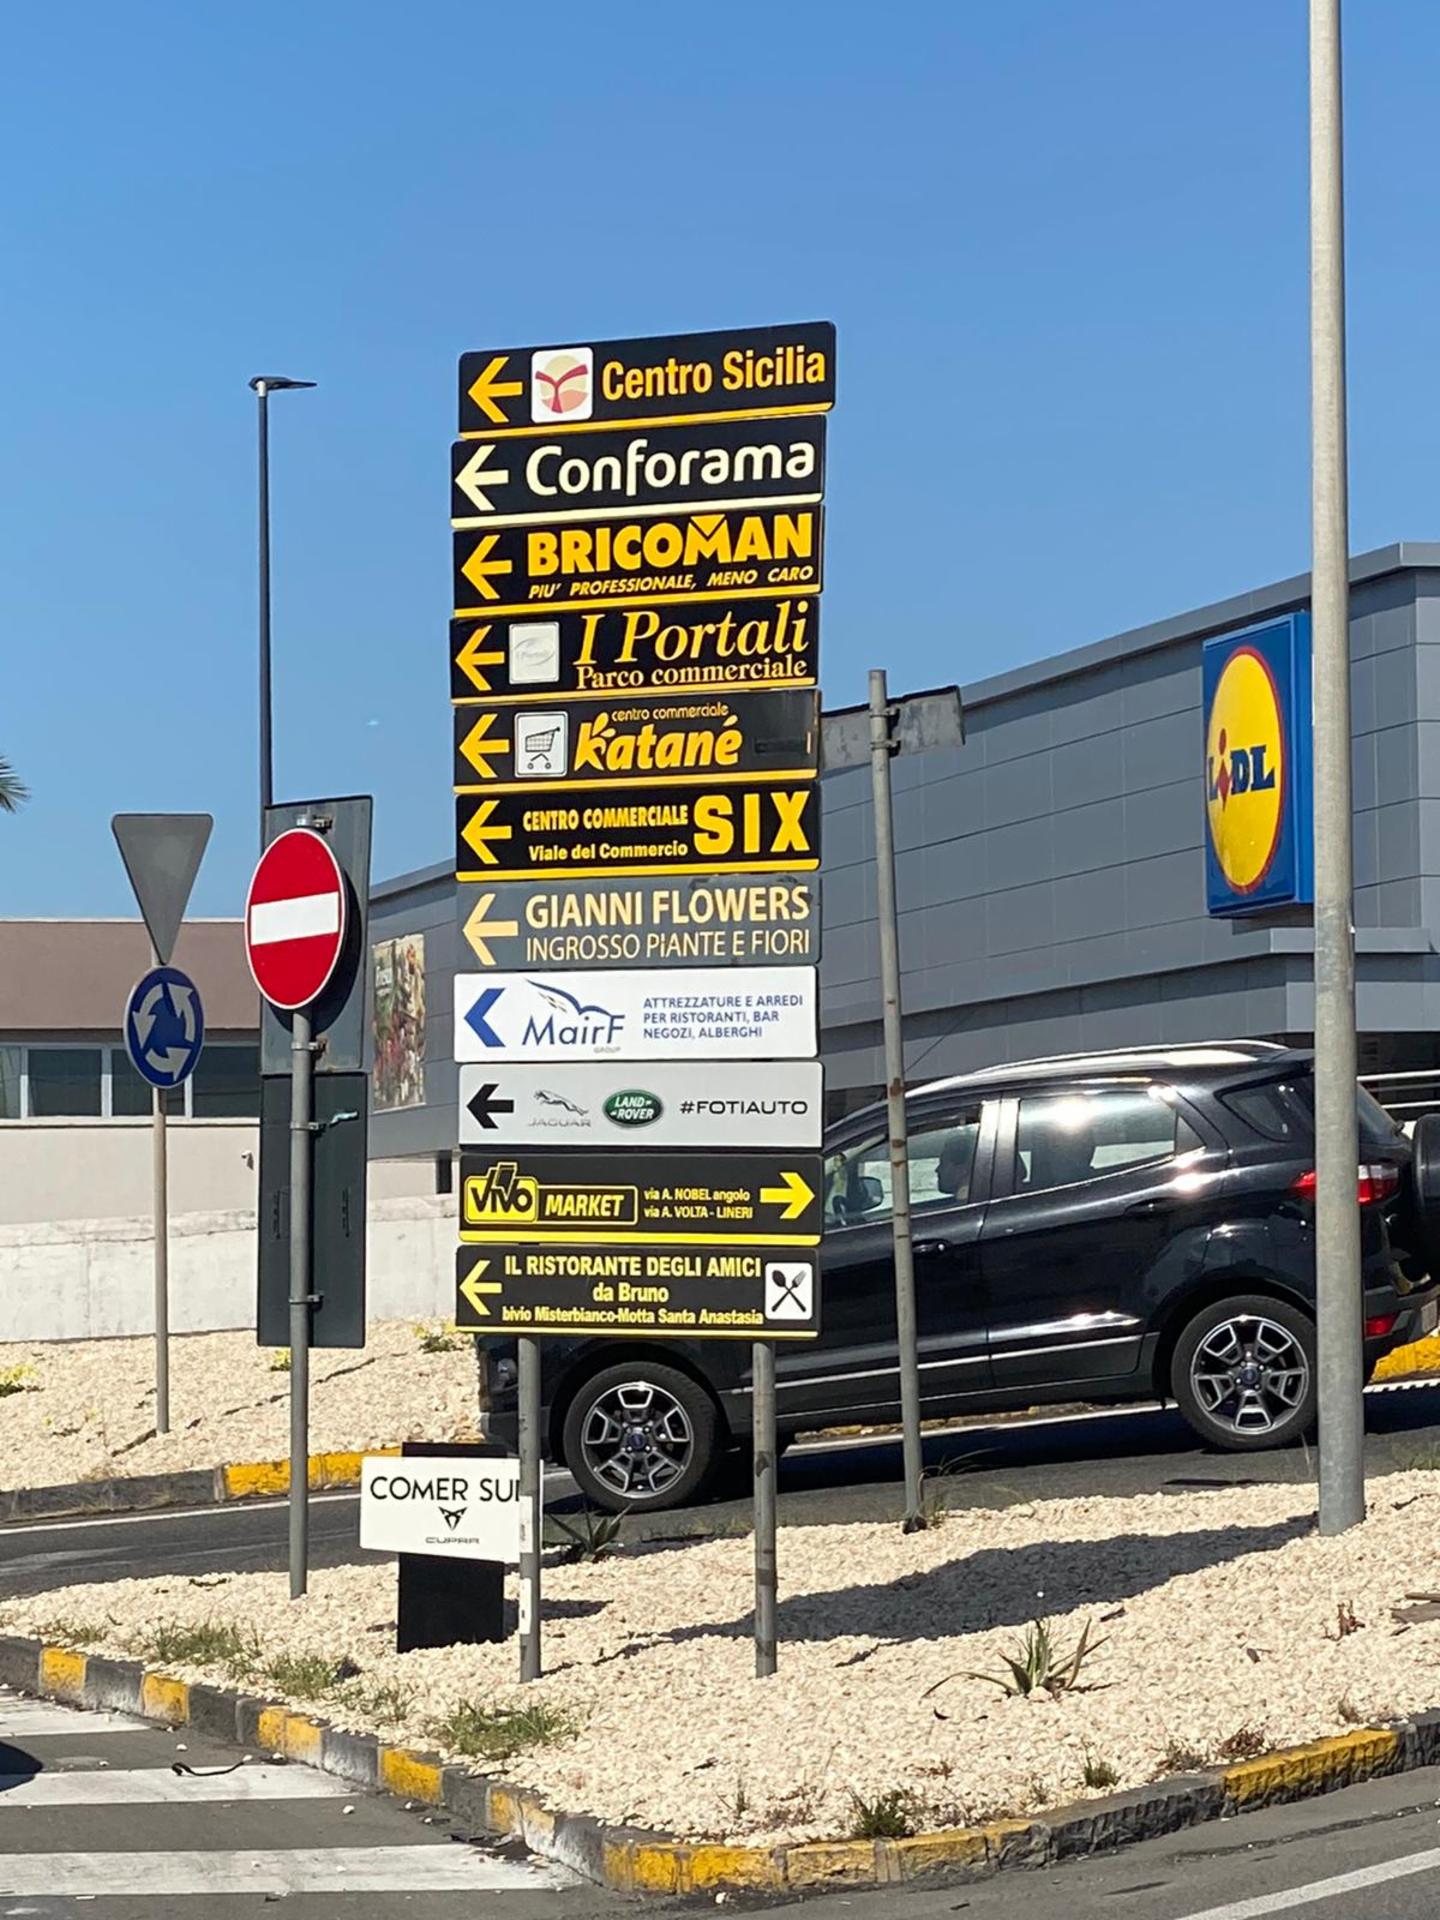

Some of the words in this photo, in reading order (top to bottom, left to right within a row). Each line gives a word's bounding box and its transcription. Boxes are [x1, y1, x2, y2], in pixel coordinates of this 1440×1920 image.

[602, 358, 712, 400] Centro
[722, 345, 826, 391] Sicilia
[525, 438, 815, 497] Conforama
[527, 513, 813, 577] BRICOMAN
[569, 574, 697, 597] PROFESSIONALE,
[707, 569, 758, 588] MENO
[767, 565, 814, 582] CARO
[573, 614, 605, 666] I
[614, 600, 809, 665] Portali
[576, 665, 645, 690] Parco
[650, 652, 807, 683] commerciale
[611, 708, 650, 722] centro
[652, 702, 729, 720] commerciale
[522, 808, 579, 832] CENTRO
[582, 804, 689, 830] COMMERCIALE
[693, 790, 811, 856] SIX
[528, 844, 568, 861] Viale
[571, 843, 596, 859] del
[599, 840, 688, 859] Commercio
[525, 891, 642, 929] GIANNI
[653, 885, 810, 924] FLOWERS
[526, 932, 640, 962] INGROSSO
[732, 930, 745, 956] E
[751, 929, 810, 955] FIORI
[643, 995, 741, 1009] ATTREZZATURE
[745, 995, 753, 1007] E
[756, 994, 803, 1006] ARREDI
[643, 1012, 667, 1024] PER
[670, 1011, 750, 1025] RISTORANTI,
[753, 1010, 780, 1022] BAR
[643, 1027, 695, 1040] NEGOZI,
[698, 1026, 763, 1039] ALBERGHI
[680, 1099, 808, 1116] #FOTIAUTO
[528, 1118, 591, 1127] JAGUAR
[544, 1194, 624, 1217] MARKET
[644, 1187, 660, 1200] via
[662, 1188, 673, 1200] A.
[674, 1188, 712, 1200] NOBEL
[713, 1188, 751, 1203] angolo
[644, 1205, 660, 1217] via
[661, 1206, 673, 1218] A.
[674, 1206, 709, 1218] VOLTA
[716, 1206, 753, 1218] LINERI
[505, 1255, 523, 1275] IL
[526, 1255, 642, 1276] RISTORANTE
[646, 1256, 701, 1277] DEGLI
[706, 1257, 761, 1277] AMICI
[592, 1281, 614, 1301] da
[618, 1282, 669, 1302] Bruno
[502, 1306, 532, 1321] bivio
[534, 1306, 655, 1323] Misterbianco-Motta
[658, 1308, 696, 1324] Santa
[698, 1308, 764, 1325] Anastasia
[370, 1476, 469, 1501] COMER
[479, 1477, 520, 1502] SU
